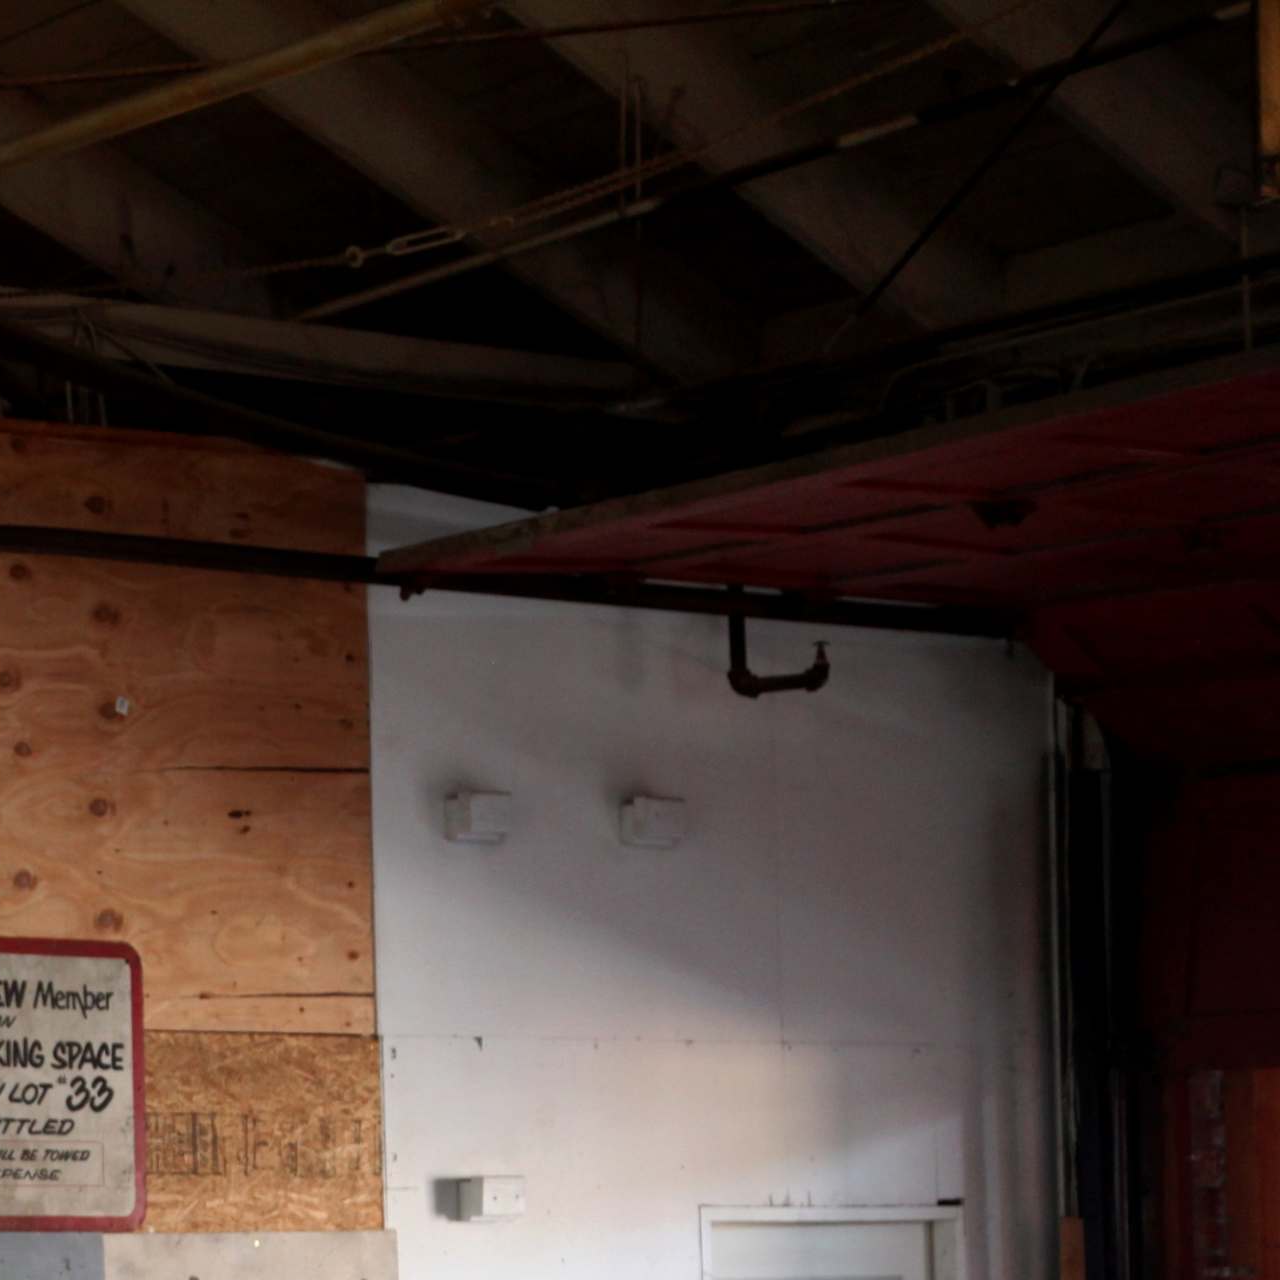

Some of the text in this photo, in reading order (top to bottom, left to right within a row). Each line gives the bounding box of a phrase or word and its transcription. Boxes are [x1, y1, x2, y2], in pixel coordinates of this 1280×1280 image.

[33, 980, 114, 1019] Member
[51, 1041, 125, 1071] SPACE
[8, 1082, 53, 1105] LOT
[20, 1148, 39, 1162] BE
[42, 1148, 92, 1162] TOWED
